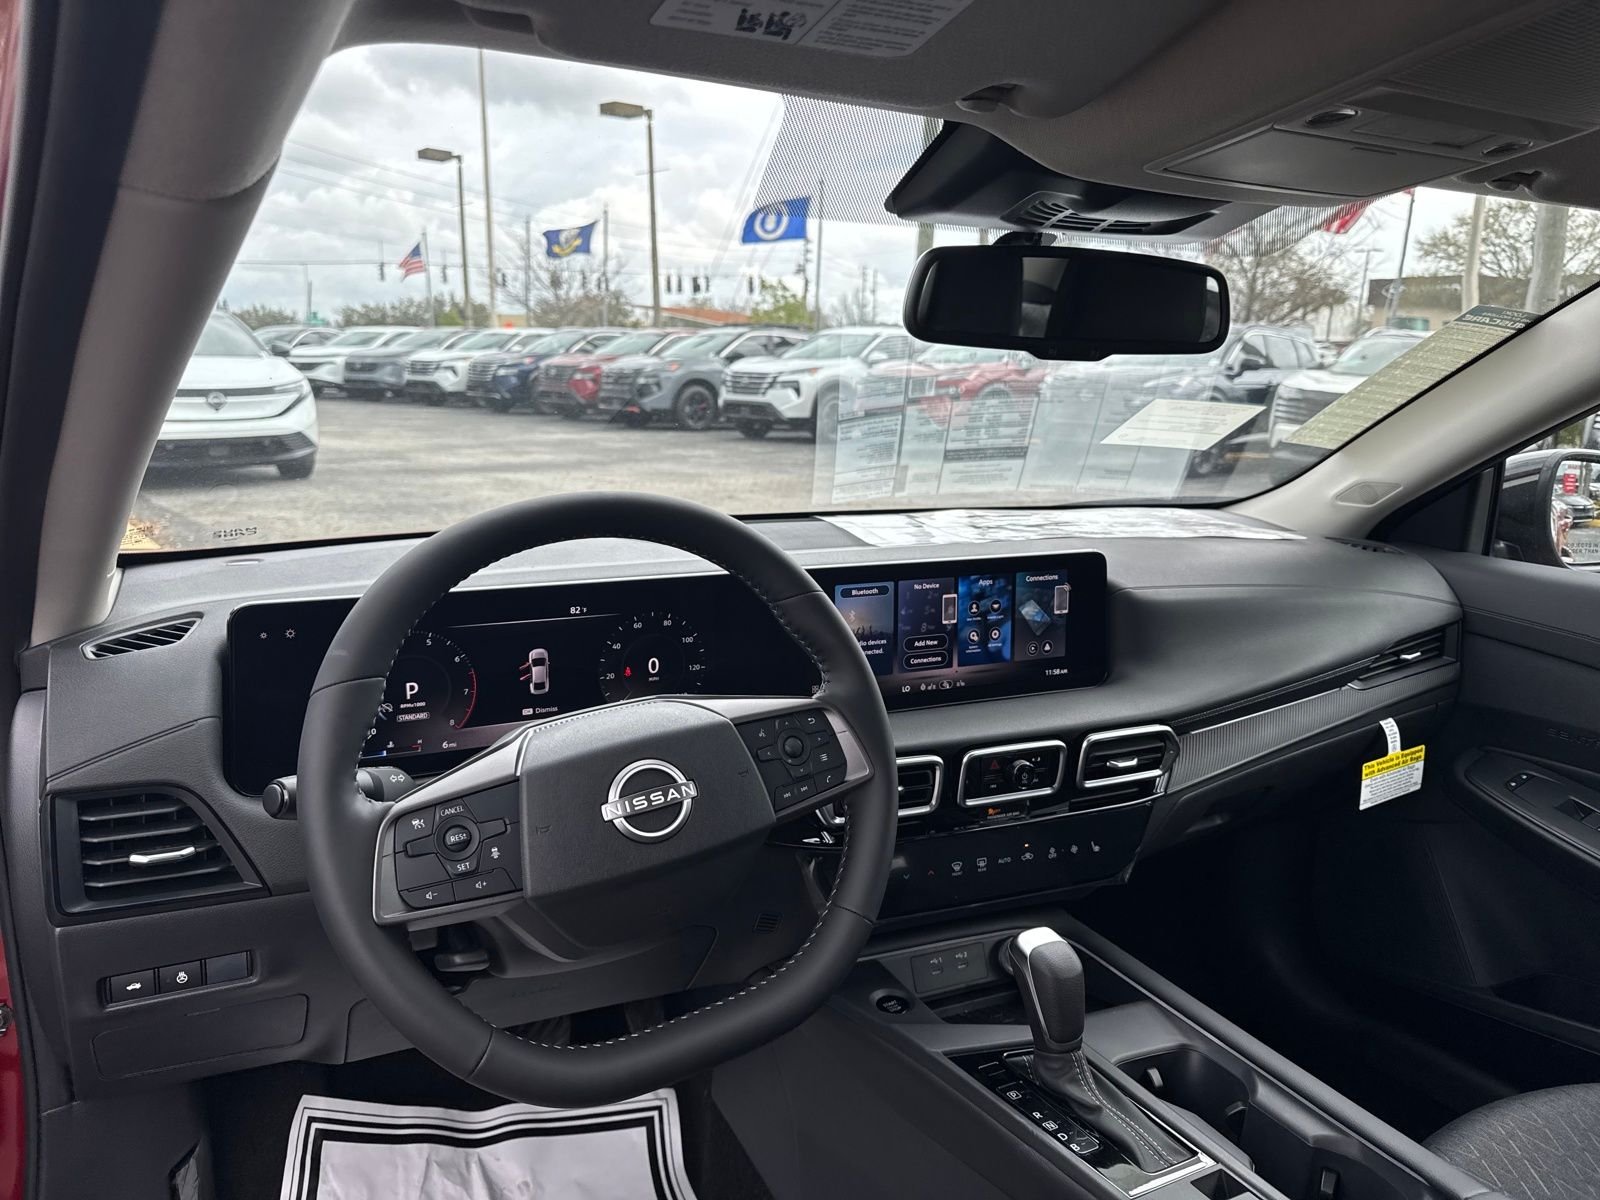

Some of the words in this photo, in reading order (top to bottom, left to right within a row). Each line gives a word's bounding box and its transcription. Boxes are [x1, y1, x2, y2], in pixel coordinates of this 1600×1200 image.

[1025, 574, 1058, 582] Connections
[978, 579, 993, 588] Apps
[570, 606, 581, 614] 82
[612, 642, 621, 650] 40
[910, 656, 942, 664] Connections
[648, 657, 660, 674] 0
[606, 672, 615, 680] 20
[405, 682, 419, 700] P
[463, 688, 469, 696] 7
[901, 685, 911, 693] LO
[535, 706, 558, 714] Dismiss
[398, 712, 428, 721] STANDARD
[1376, 757, 1395, 767] Vehicle
[1401, 747, 1423, 758] Equipped
[1377, 761, 1400, 772] Advanced
[604, 783, 695, 819] NISSAN
[440, 801, 465, 817] CANCEL
[456, 862, 470, 872] SET
[1032, 1111, 1043, 1120] R
[1057, 1132, 1068, 1141] D
[1069, 1143, 1080, 1152] B
